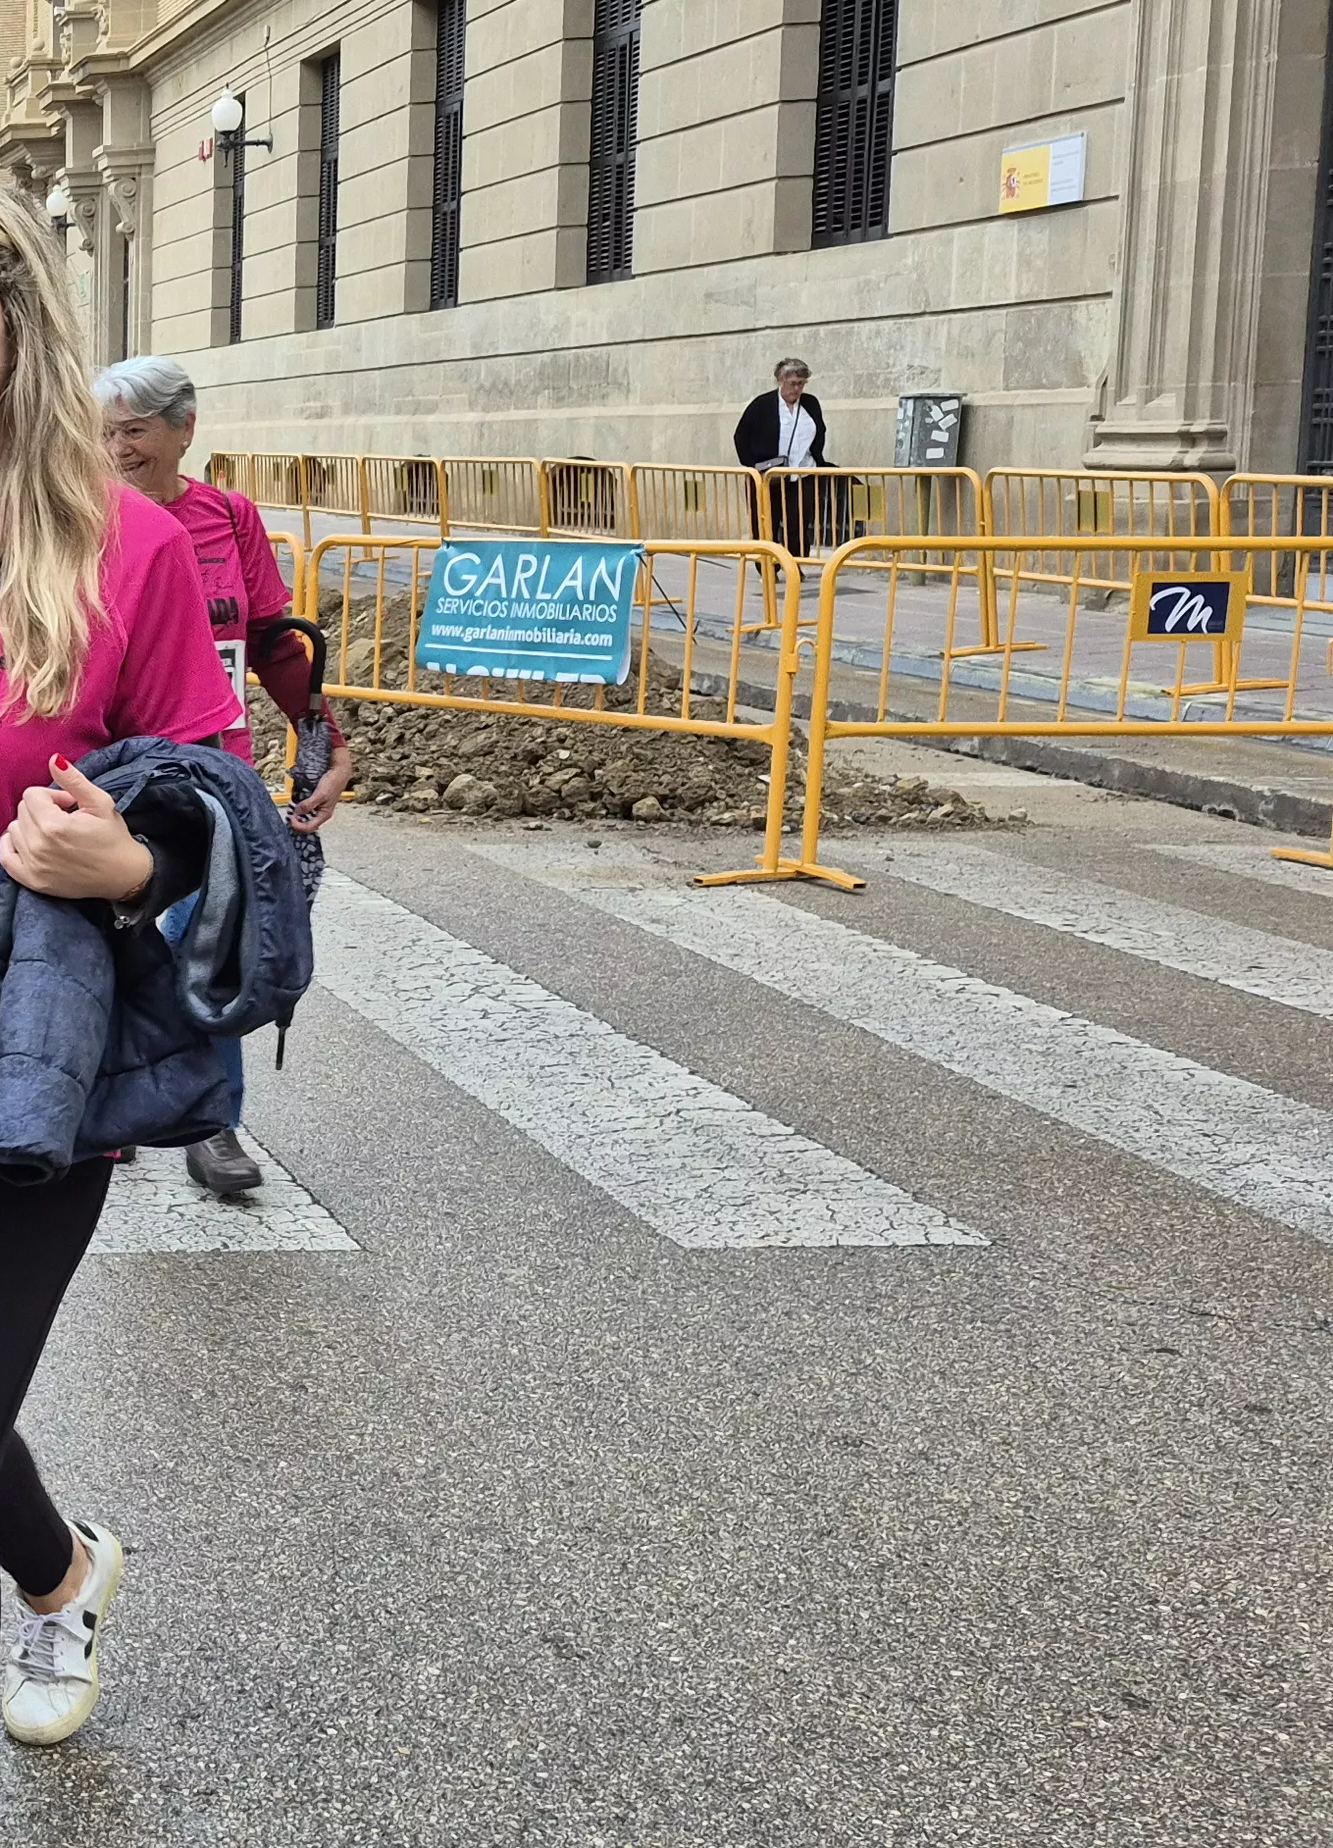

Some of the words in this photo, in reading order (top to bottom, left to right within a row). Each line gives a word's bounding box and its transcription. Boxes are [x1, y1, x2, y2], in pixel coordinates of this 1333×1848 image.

[443, 552, 626, 602] GARLAN
[436, 596, 508, 619] SERVICIOS
[509, 600, 618, 623] INMOBILIARIOS
[431, 622, 613, 647] www.garlaninmobiliaria.com
